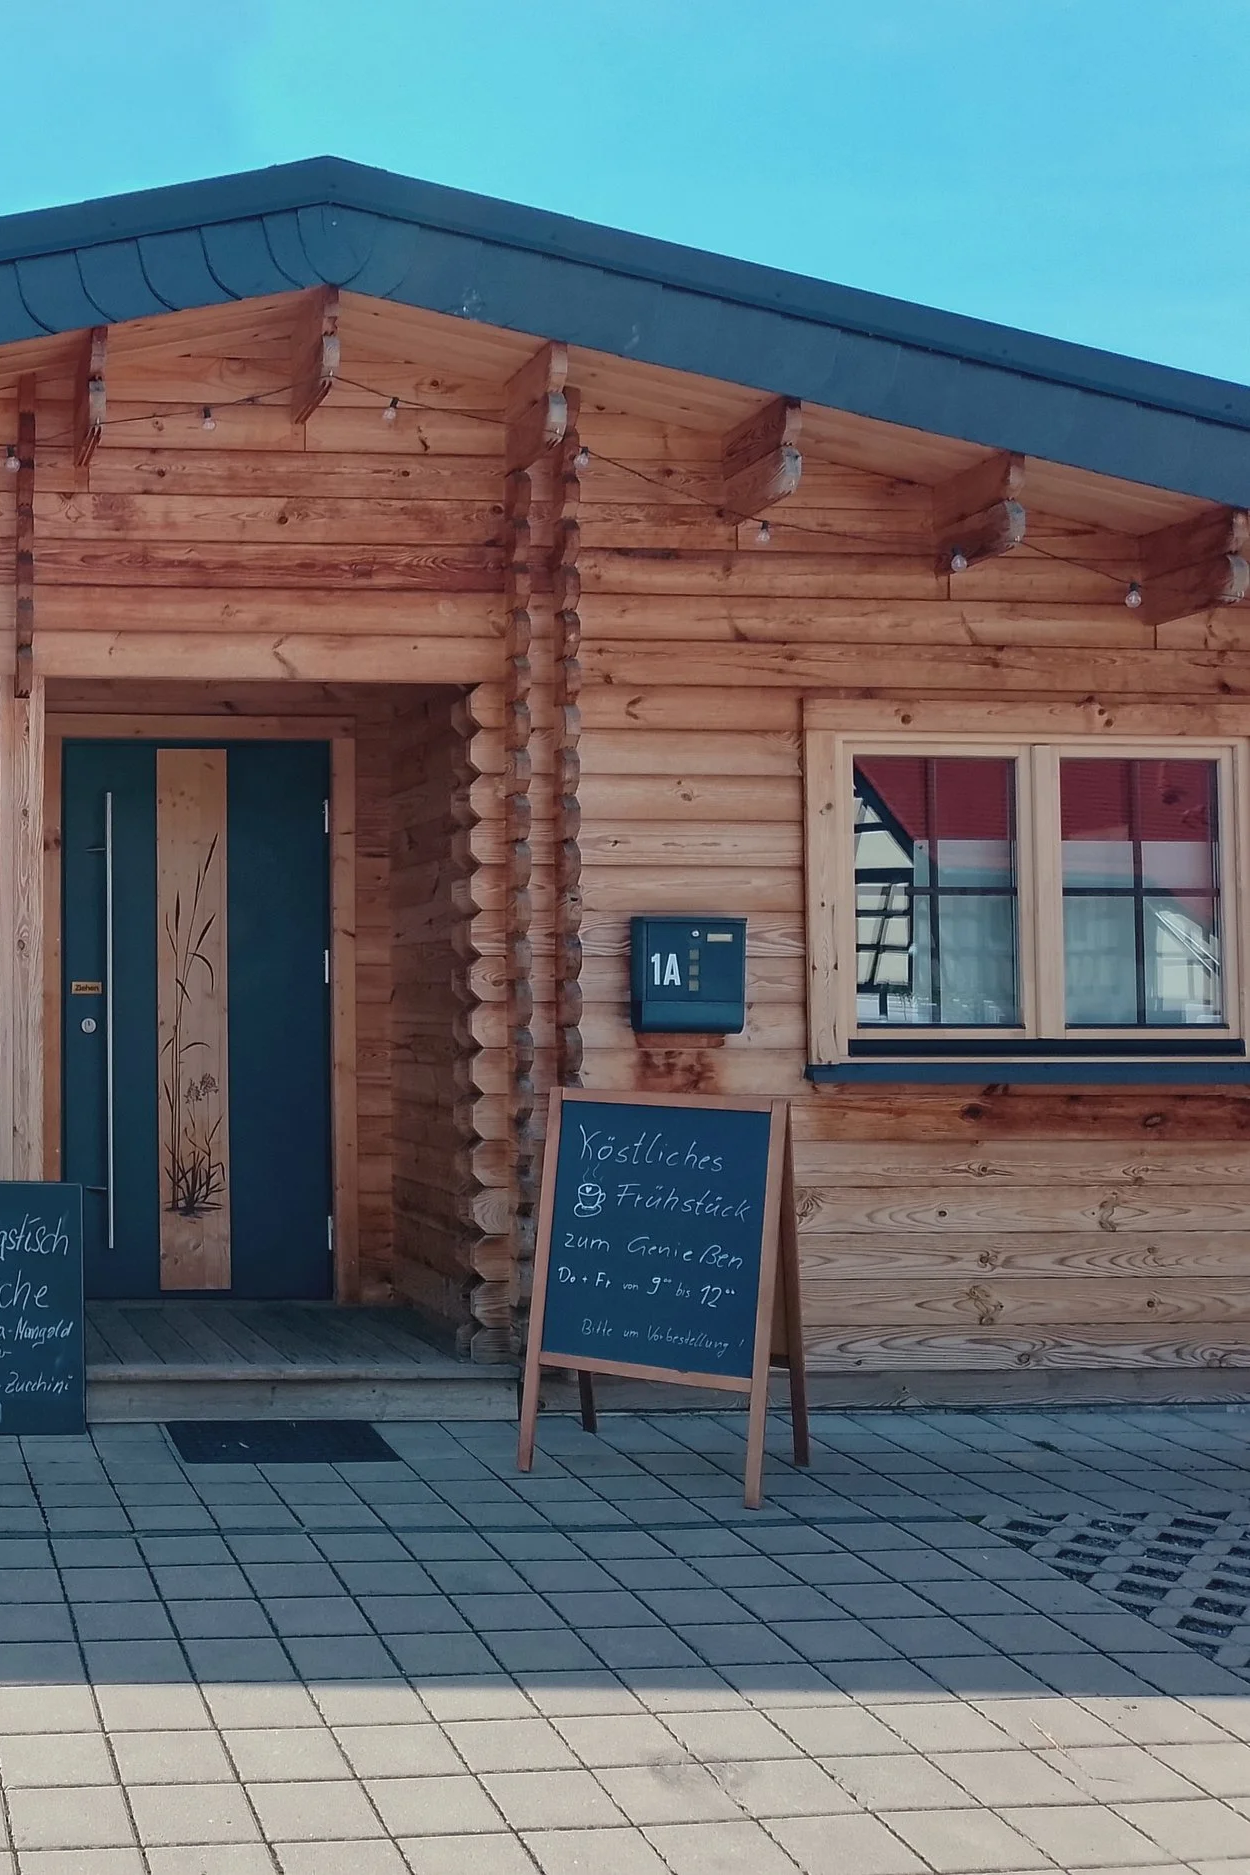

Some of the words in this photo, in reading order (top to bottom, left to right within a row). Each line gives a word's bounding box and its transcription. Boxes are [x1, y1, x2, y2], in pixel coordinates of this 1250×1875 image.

[650, 953, 681, 986] 1A
[74, 984, 100, 992] Ziehen
[579, 1124, 723, 1171] Köstliches
[617, 1183, 751, 1222] Frühstück
[564, 1232, 610, 1253] zum
[558, 1266, 576, 1284] Do
[595, 1271, 611, 1289] Fr
[622, 1282, 639, 1292] von
[675, 1281, 691, 1298] bis
[581, 1318, 614, 1338] Bitte
[623, 1329, 640, 1339] um
